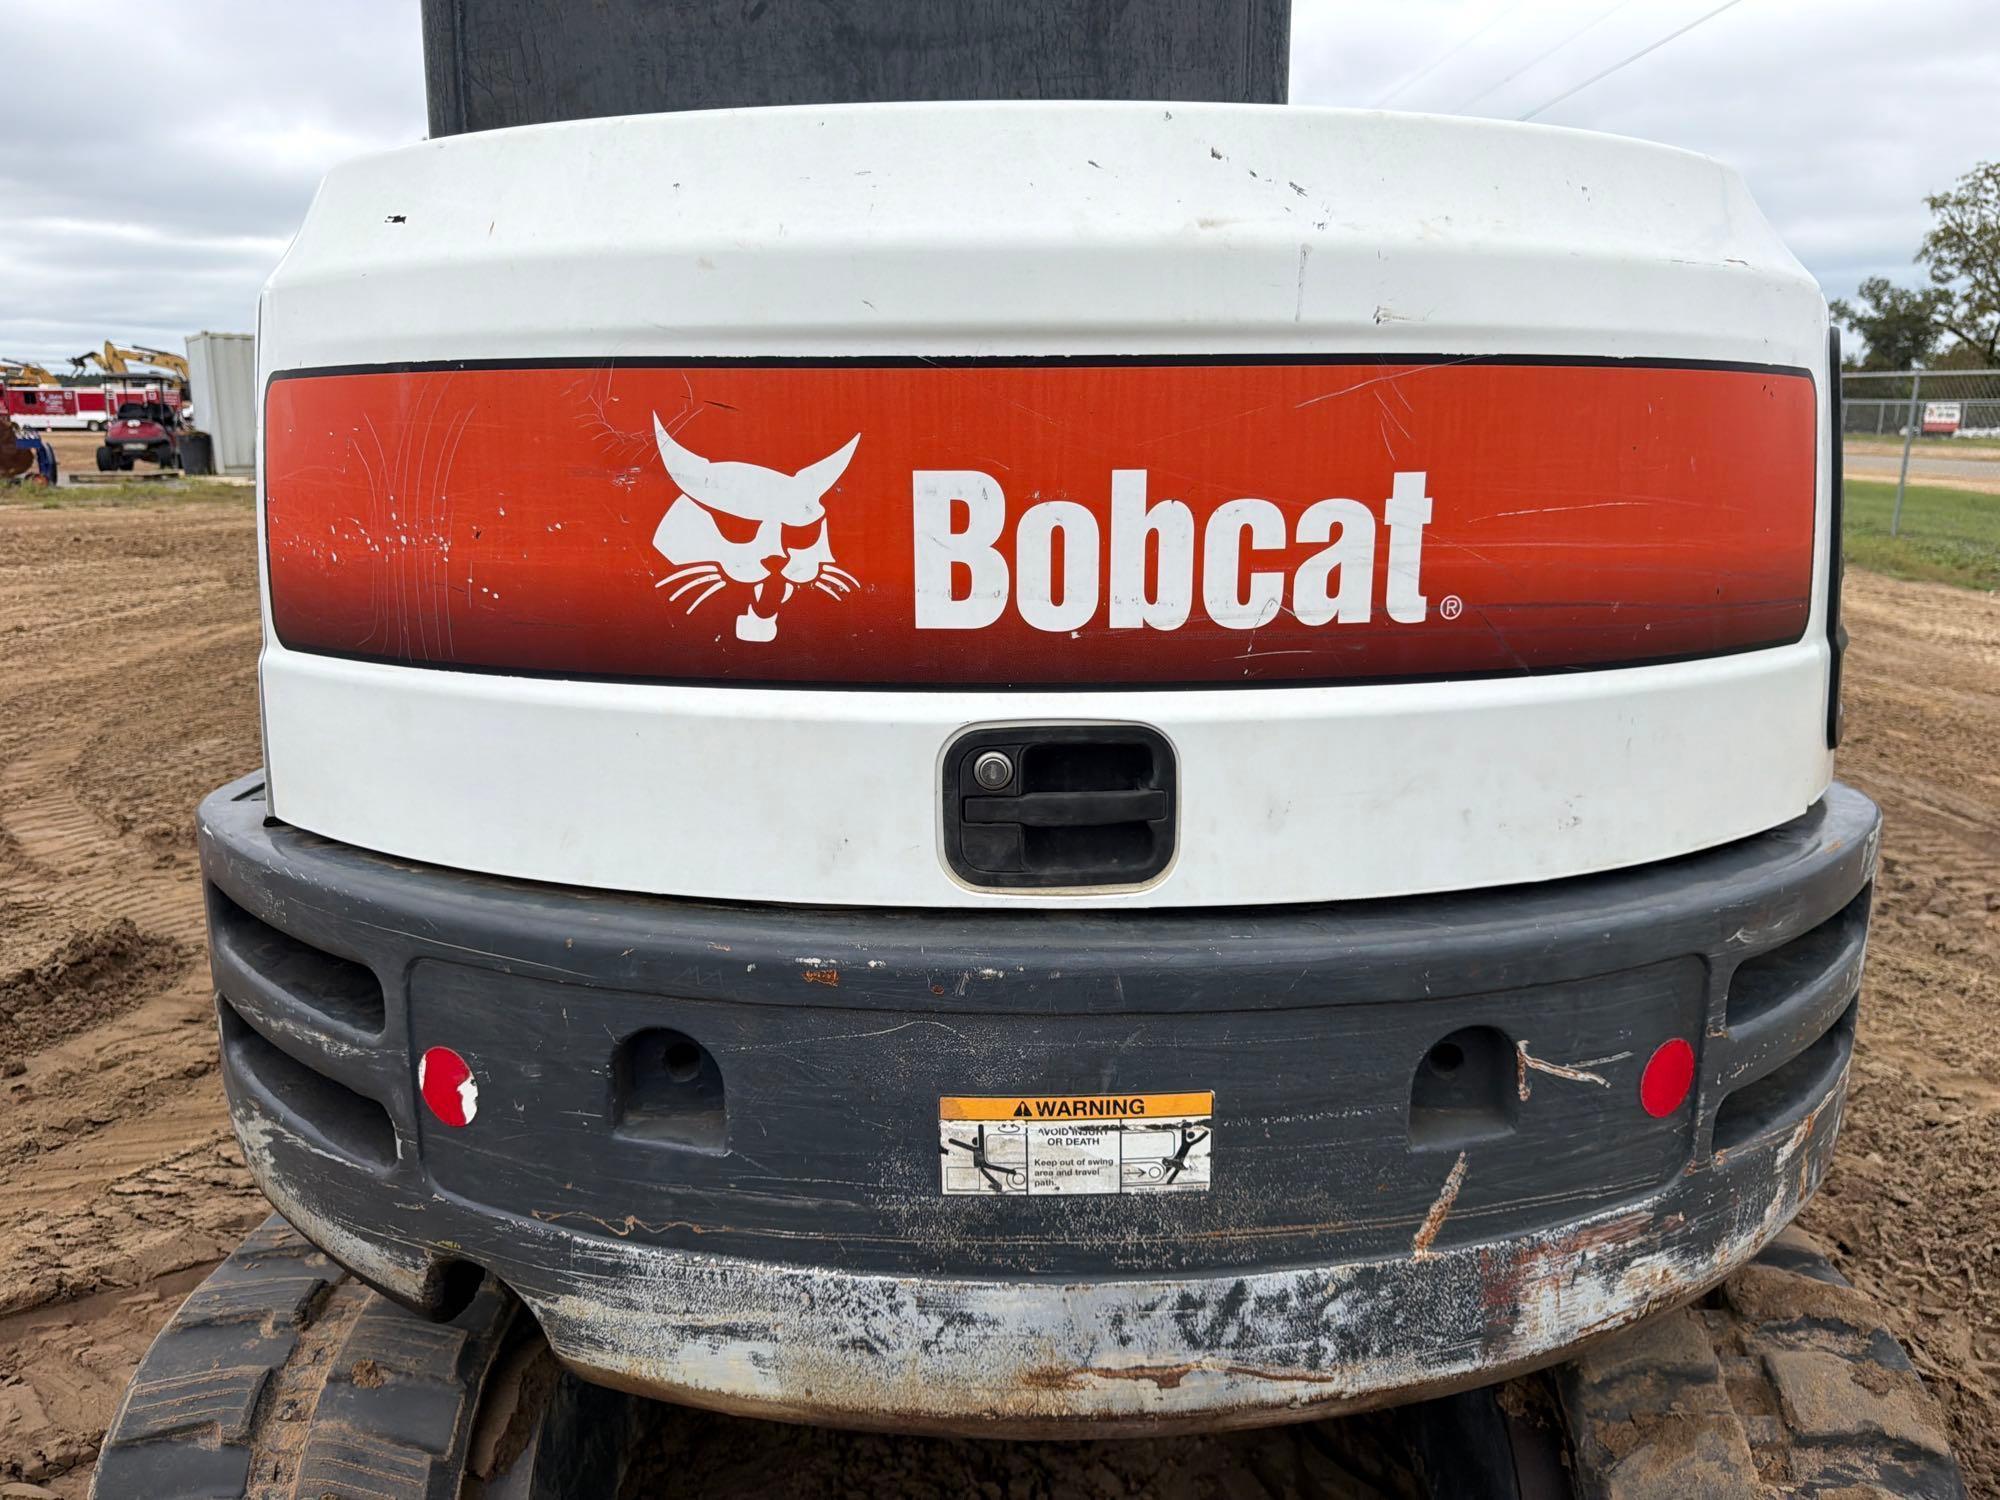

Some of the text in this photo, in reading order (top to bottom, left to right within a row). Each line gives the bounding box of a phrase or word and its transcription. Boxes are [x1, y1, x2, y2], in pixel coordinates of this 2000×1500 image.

[912, 469, 1433, 632] Bobcat
[1036, 1099, 1145, 1117] WARNING
[1039, 1128, 1069, 1136] AVOID
[1047, 1138, 1100, 1146] OR DEATH
[1034, 1158, 1058, 1168] Keep
[1076, 1158, 1086, 1166] of
[1088, 1157, 1114, 1167] swing
[1075, 1168, 1100, 1176] travel
[1034, 1179, 1057, 1187] path.
